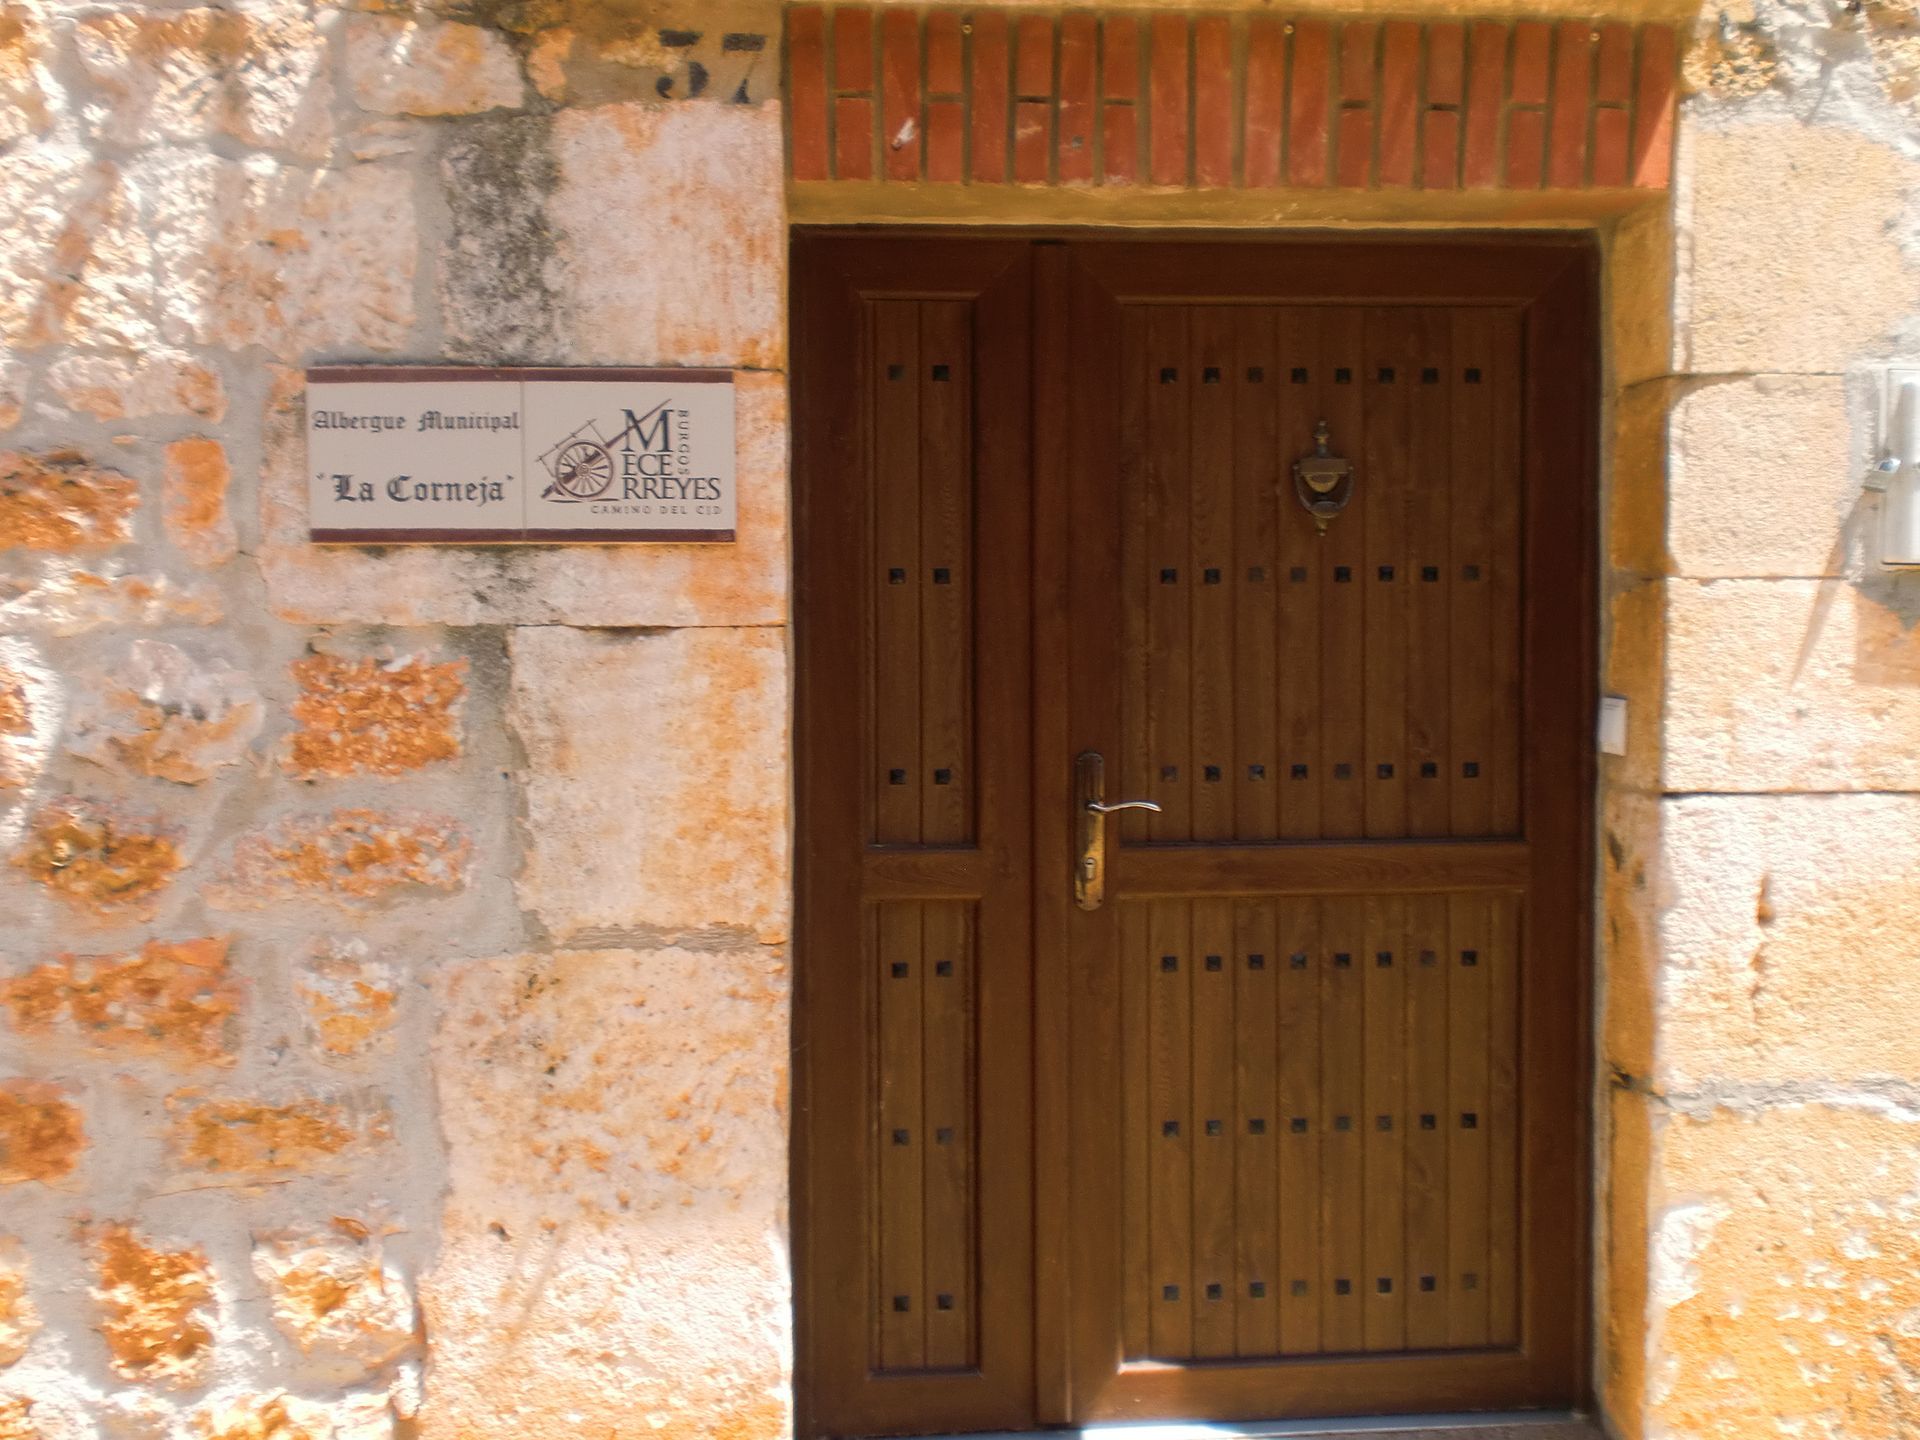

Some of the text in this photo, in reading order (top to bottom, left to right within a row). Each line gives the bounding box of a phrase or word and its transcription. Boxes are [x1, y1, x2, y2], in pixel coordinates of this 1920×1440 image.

[313, 410, 520, 433] Albergue Municipal
[677, 409, 690, 475] BURGOS
[590, 505, 722, 515] CAMINO DEL CID
